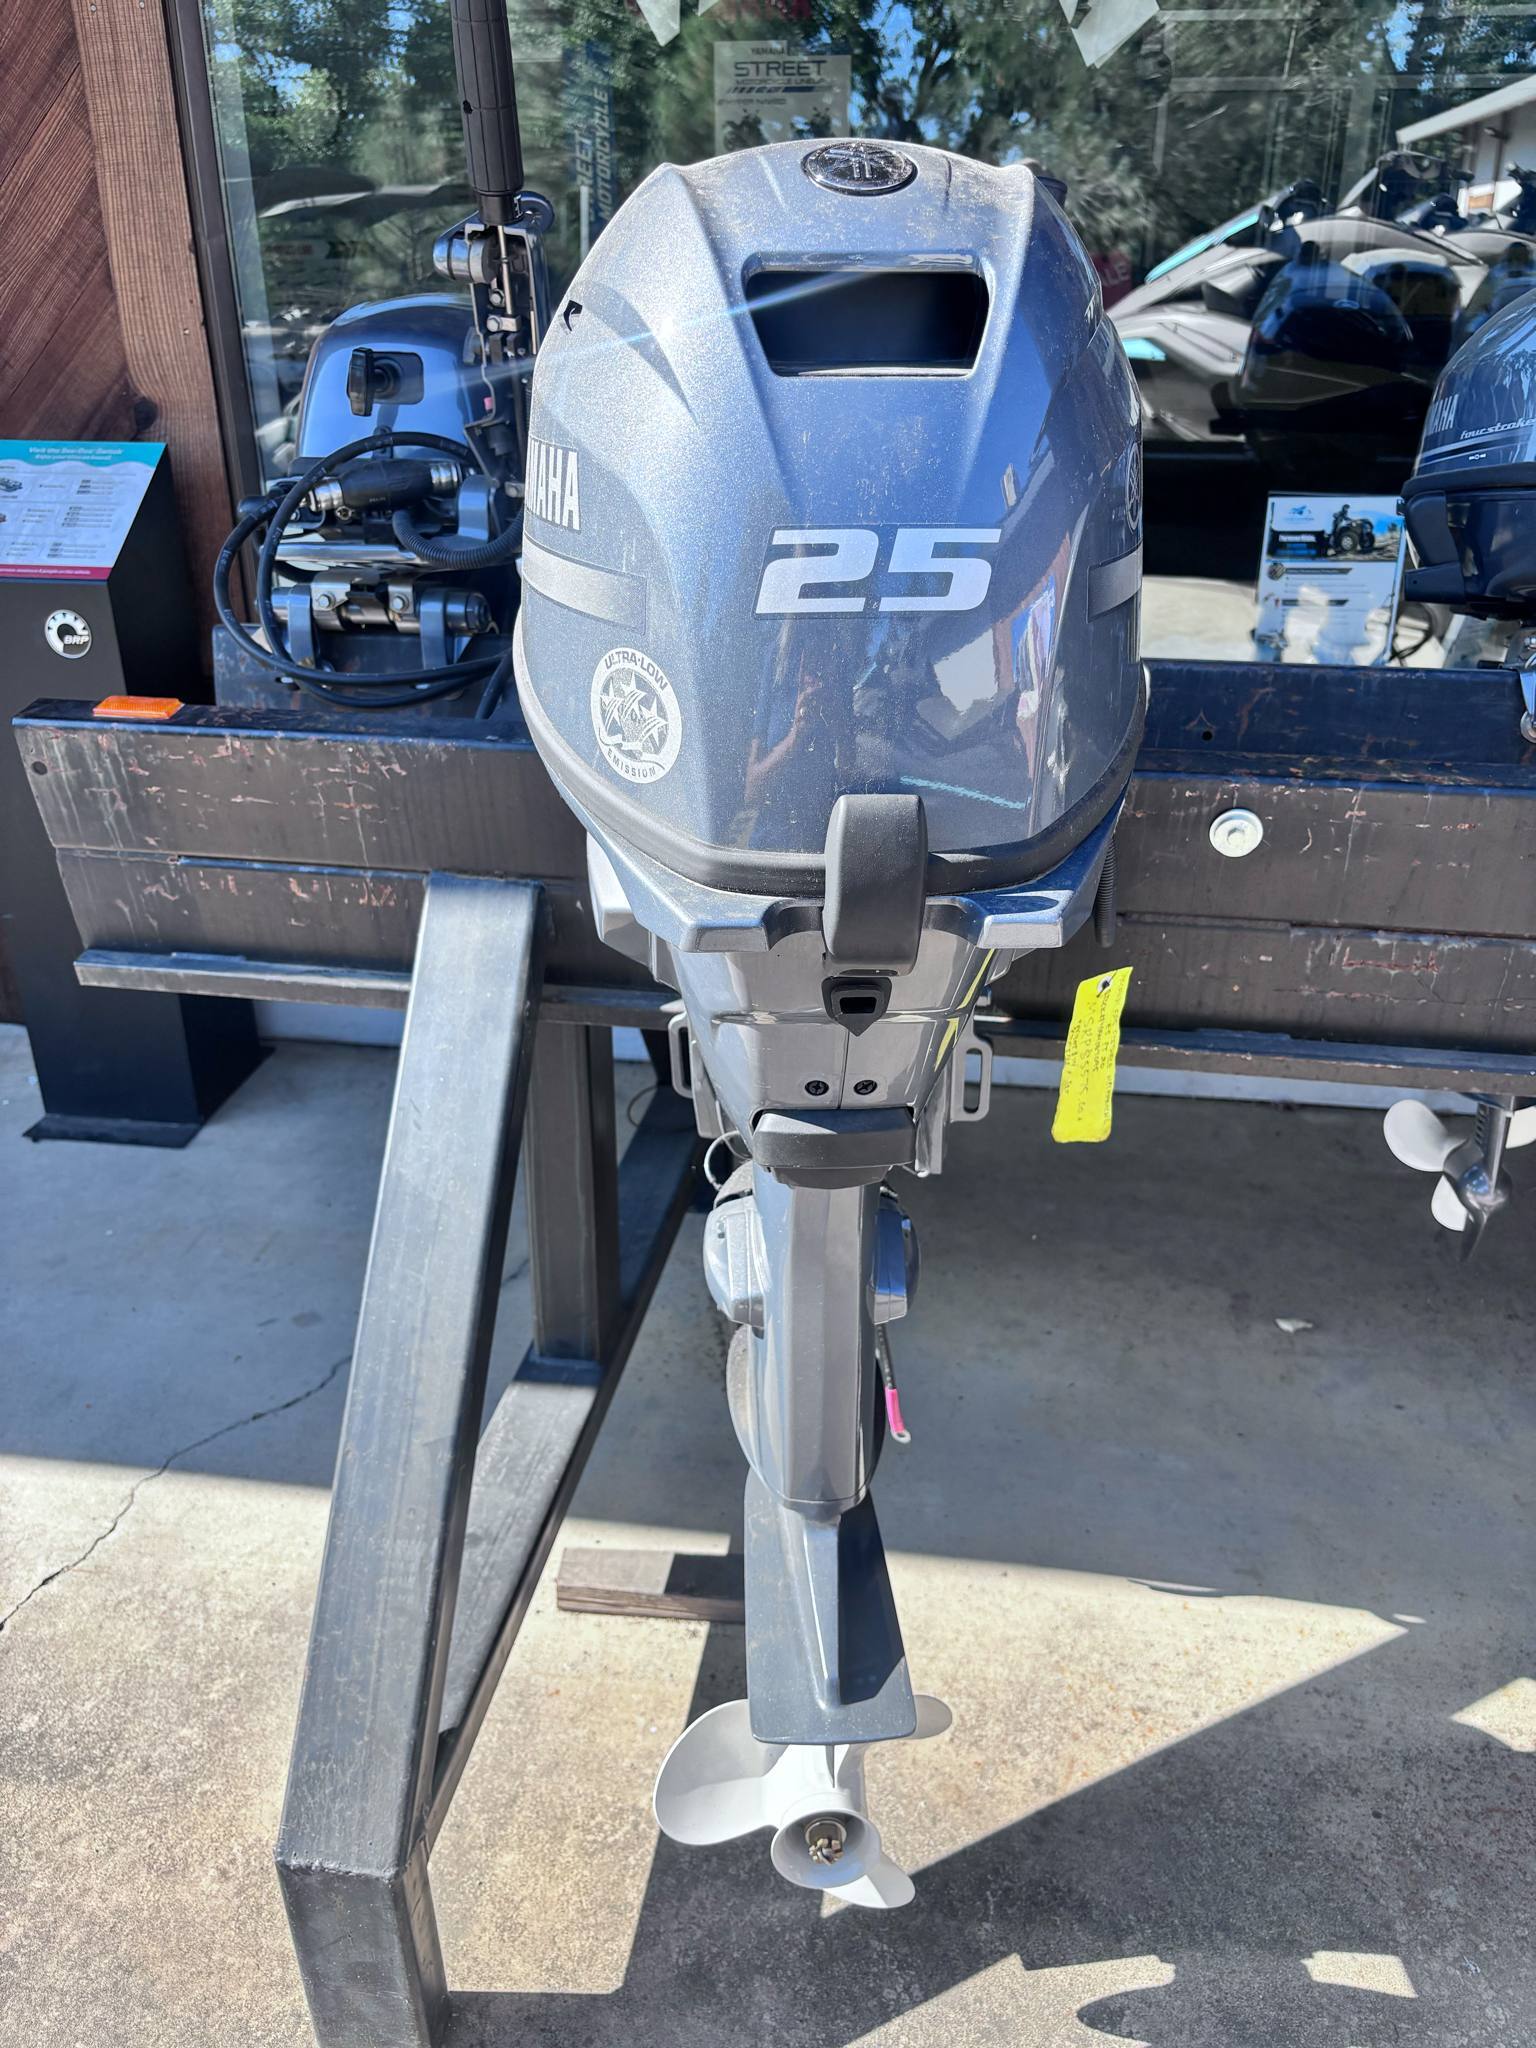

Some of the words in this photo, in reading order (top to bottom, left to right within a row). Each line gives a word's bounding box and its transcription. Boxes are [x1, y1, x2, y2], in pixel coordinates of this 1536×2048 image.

[734, 60, 828, 77] STREET
[593, 86, 614, 221] MOTORCYCLE
[525, 439, 580, 531] MAHA
[756, 528, 1002, 614] 25
[64, 634, 90, 645] BRP
[607, 747, 656, 778] EMISSION
